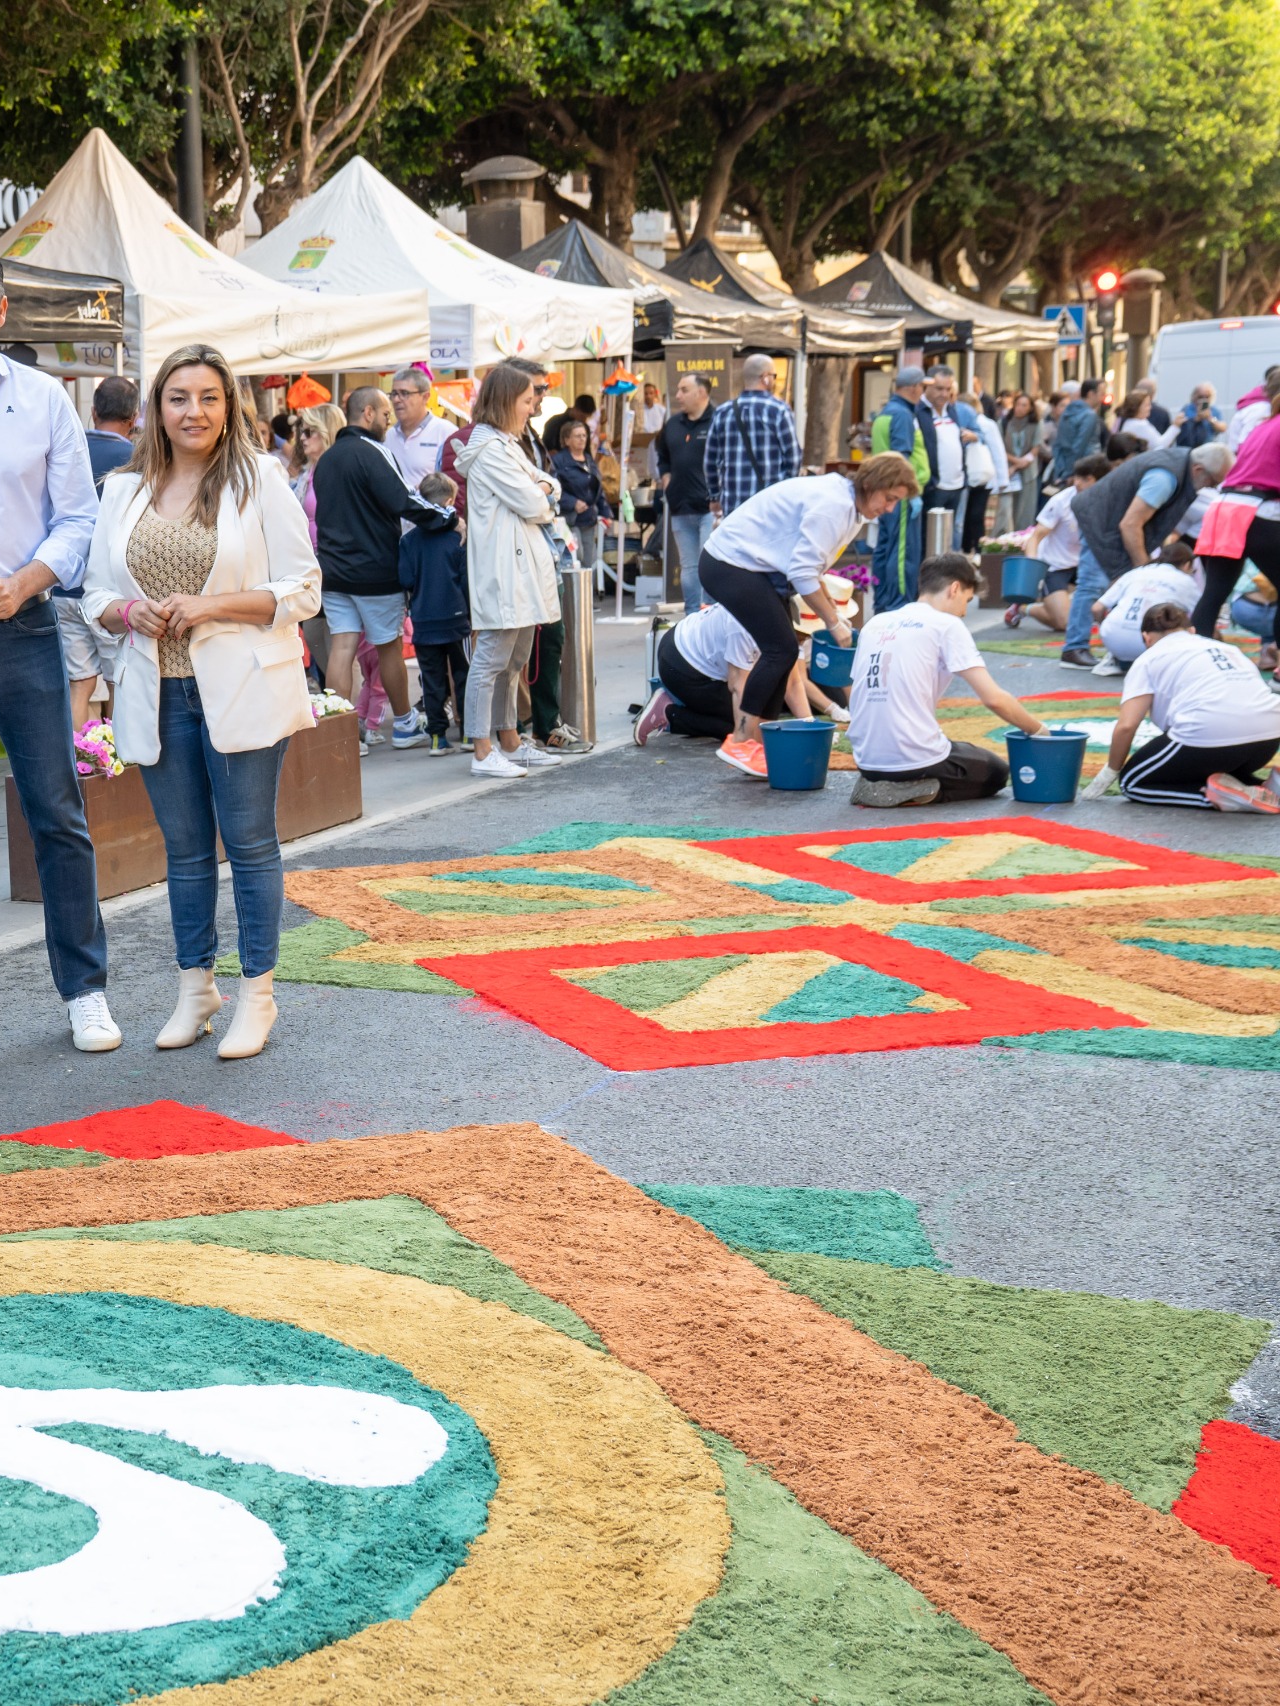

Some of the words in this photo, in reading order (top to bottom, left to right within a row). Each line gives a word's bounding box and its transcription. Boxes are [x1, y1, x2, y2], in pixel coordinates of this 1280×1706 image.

[81, 344, 132, 362] TÍJOA
[676, 360, 686, 371] EL
[687, 359, 713, 371] SABOR
[714, 359, 724, 370] DE
